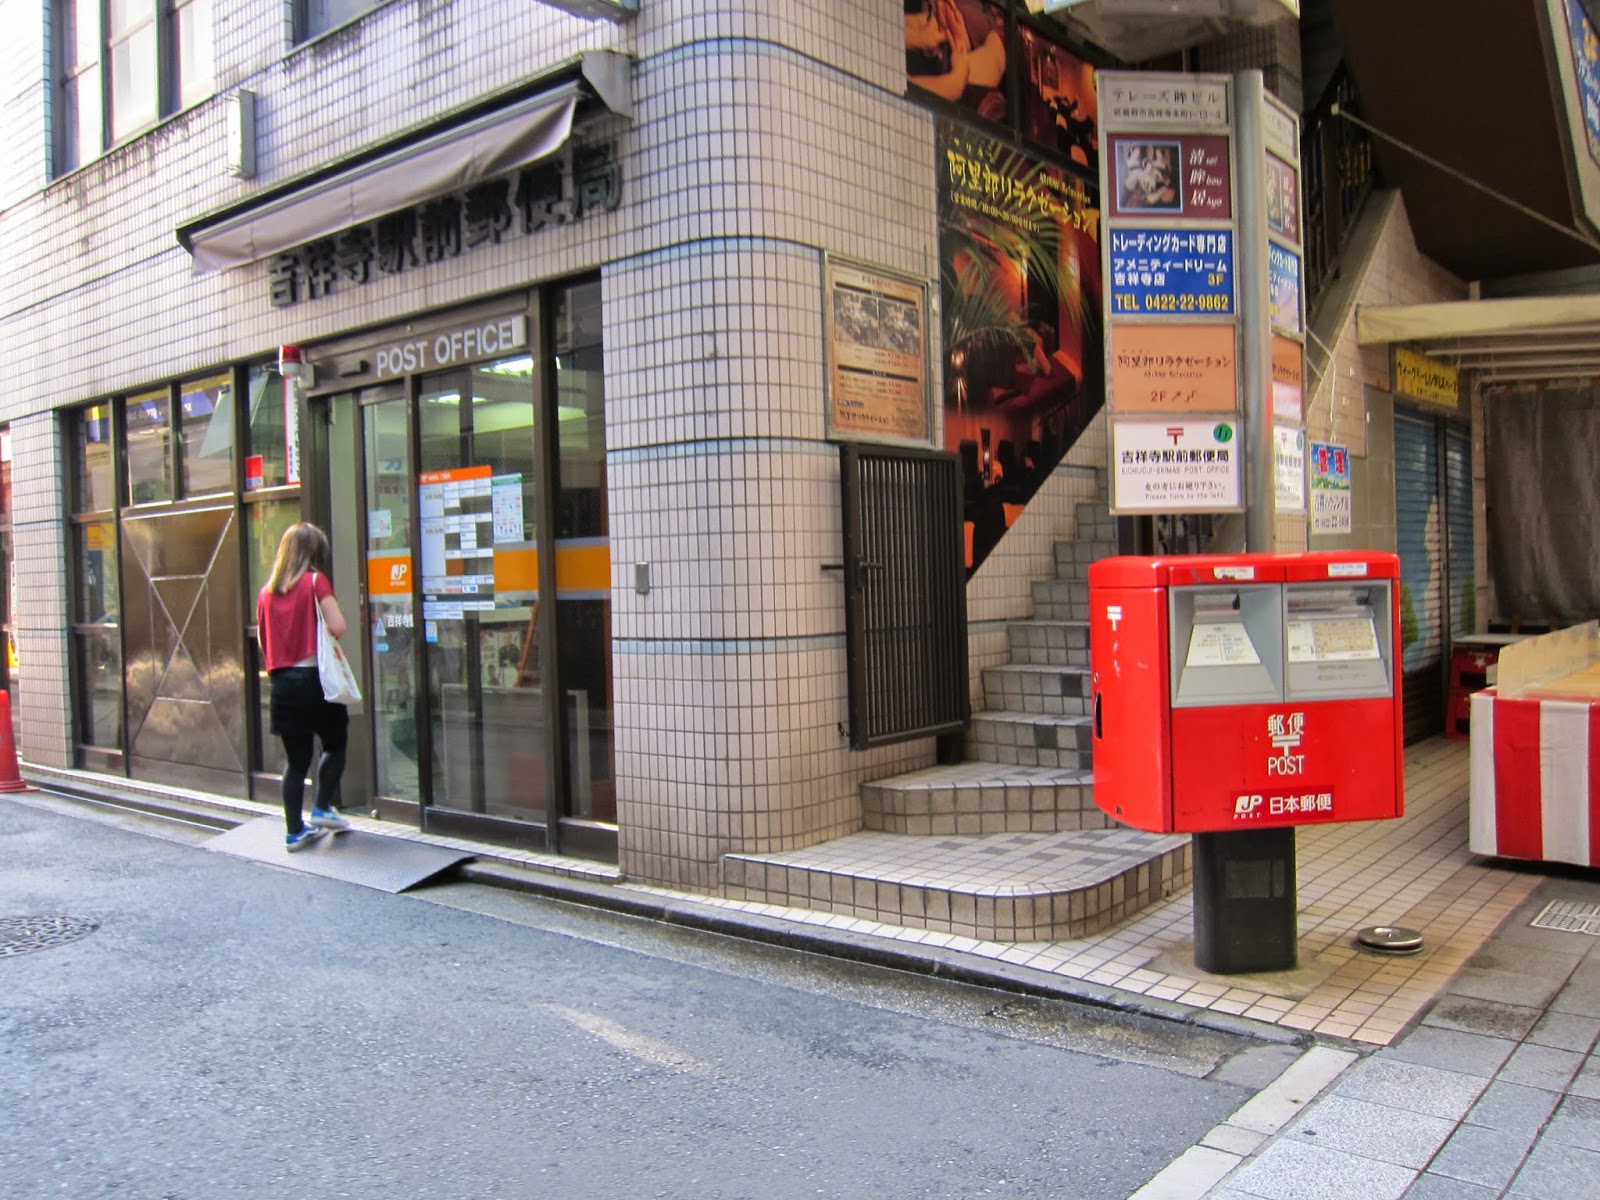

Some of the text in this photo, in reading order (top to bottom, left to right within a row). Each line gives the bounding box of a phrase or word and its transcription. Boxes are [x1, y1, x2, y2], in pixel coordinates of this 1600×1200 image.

[1112, 232, 1227, 254] トレーディングカード専門店
[1113, 258, 1227, 273] アメニティードリーム
[1114, 272, 1224, 287] 吉祥寺店 3F
[1115, 294, 1140, 311] TEL
[376, 321, 514, 378] POST OFFICE
[1151, 390, 1166, 402] 2F
[1121, 449, 1230, 464] 吉祥寺駅前郵便局
[1184, 465, 1203, 474] POST
[1206, 465, 1230, 474] OFFICE
[1267, 712, 1304, 737] 郵便
[1268, 755, 1305, 776] POST
[1269, 793, 1332, 815] 日本郵便
[1233, 812, 1261, 820] POST
